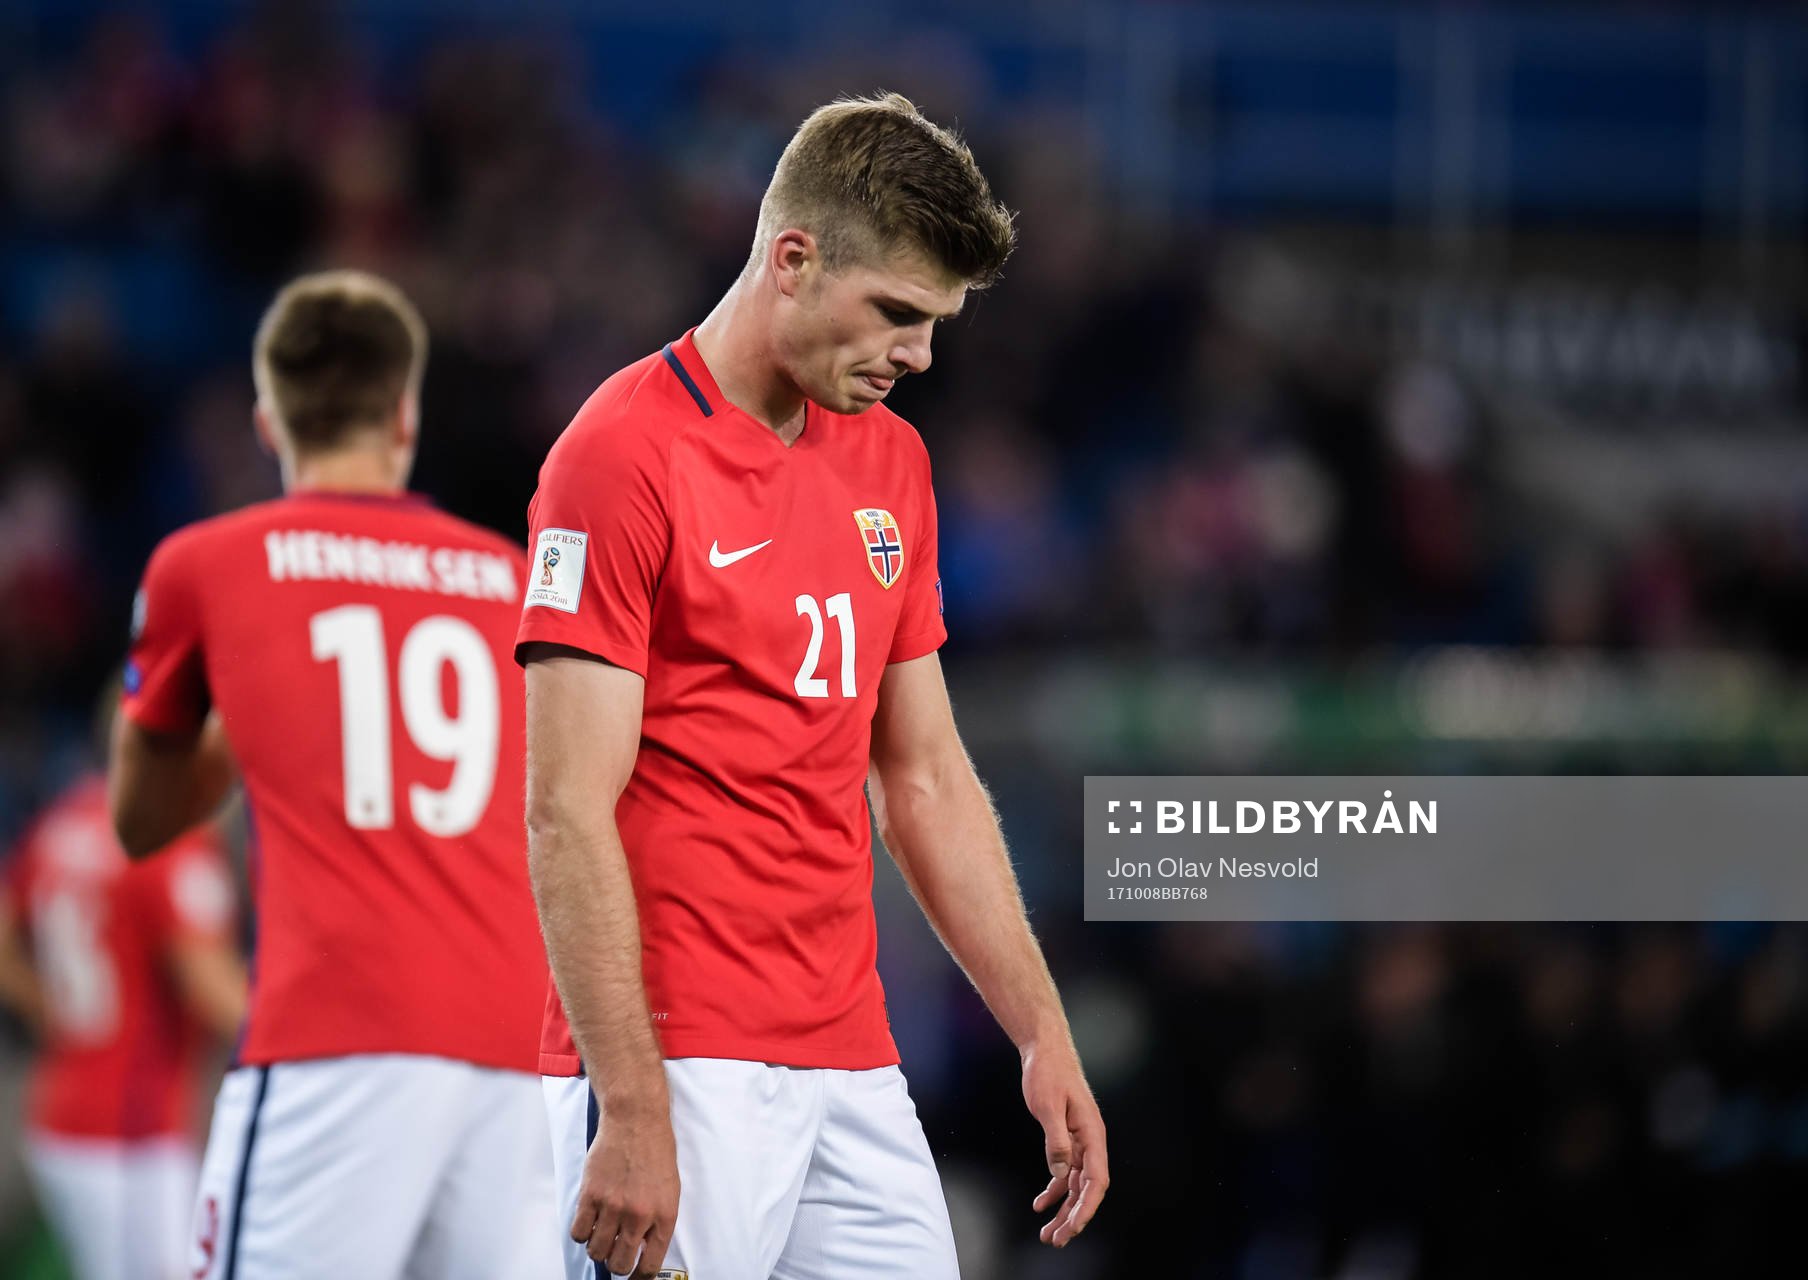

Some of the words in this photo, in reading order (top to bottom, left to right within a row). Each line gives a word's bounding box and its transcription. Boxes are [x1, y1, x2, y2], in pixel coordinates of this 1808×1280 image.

[264, 530, 518, 604] HENRIKSEN
[540, 533, 583, 546] ALIFIERS
[793, 592, 858, 698] 21
[310, 604, 501, 838] 19
